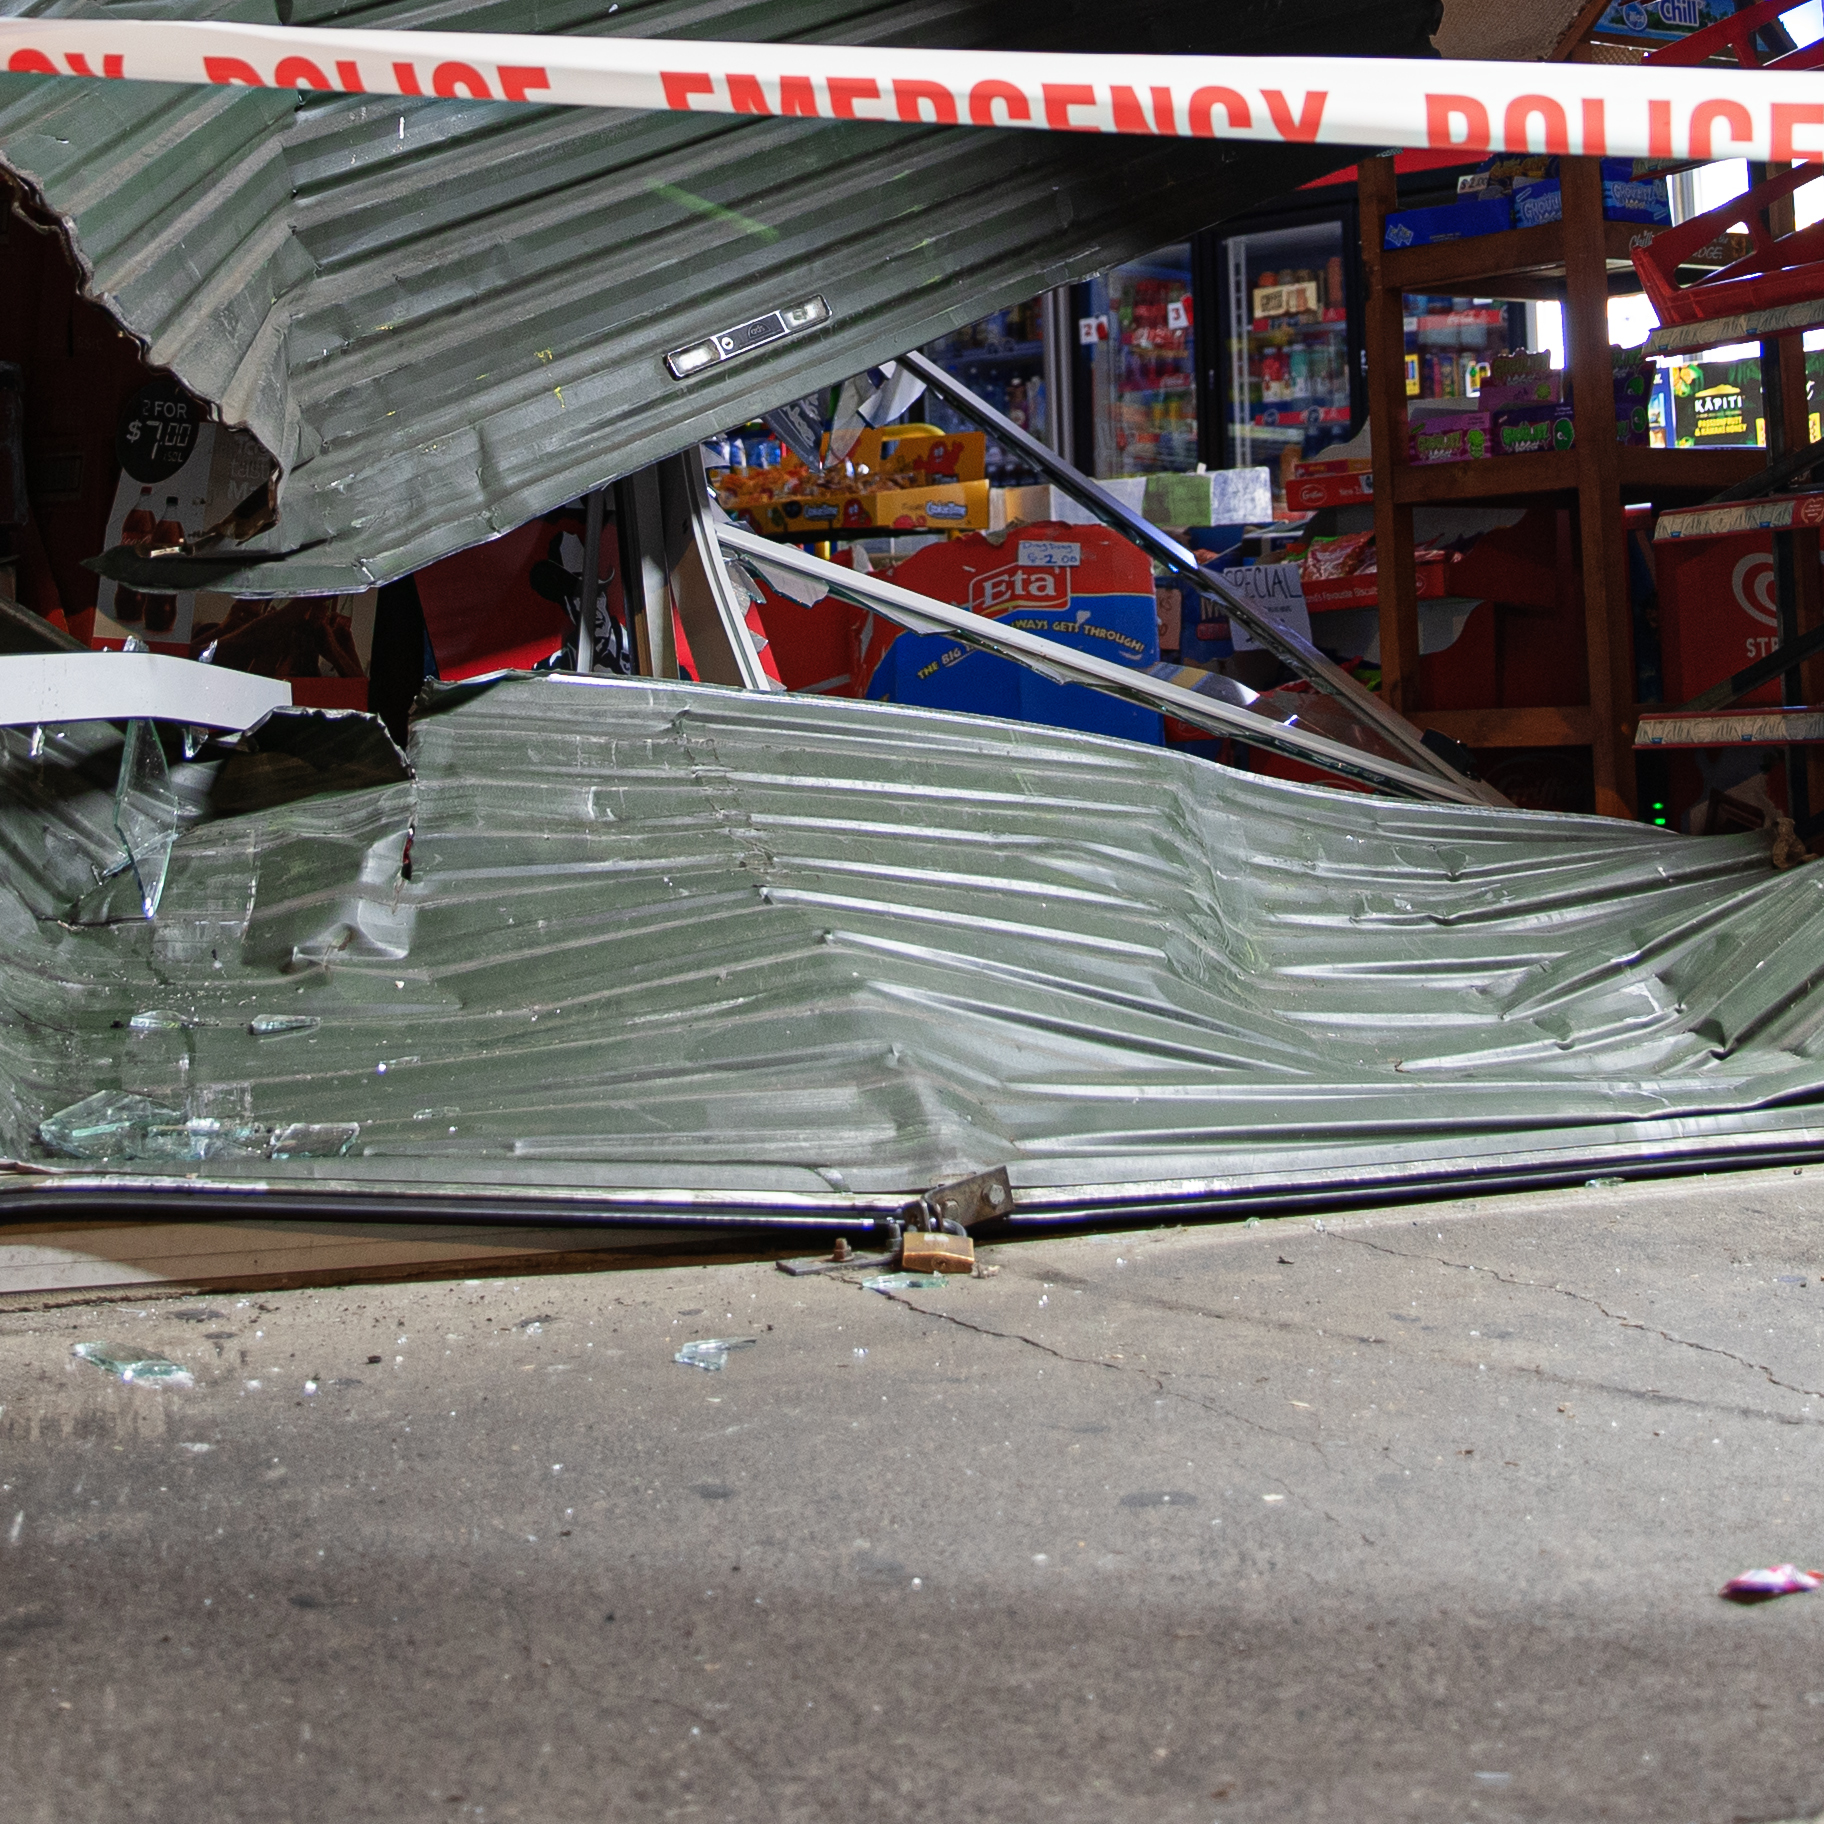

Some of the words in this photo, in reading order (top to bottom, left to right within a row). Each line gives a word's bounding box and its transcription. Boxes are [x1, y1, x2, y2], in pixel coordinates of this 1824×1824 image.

[142, 400, 151, 416] 2
[154, 401, 188, 419] FOR
[126, 419, 192, 460] $7.00
[982, 569, 1057, 608] Eta
[1083, 625, 1145, 653] THROUGH!
[917, 661, 940, 679] THE
[941, 649, 963, 665] BIG
